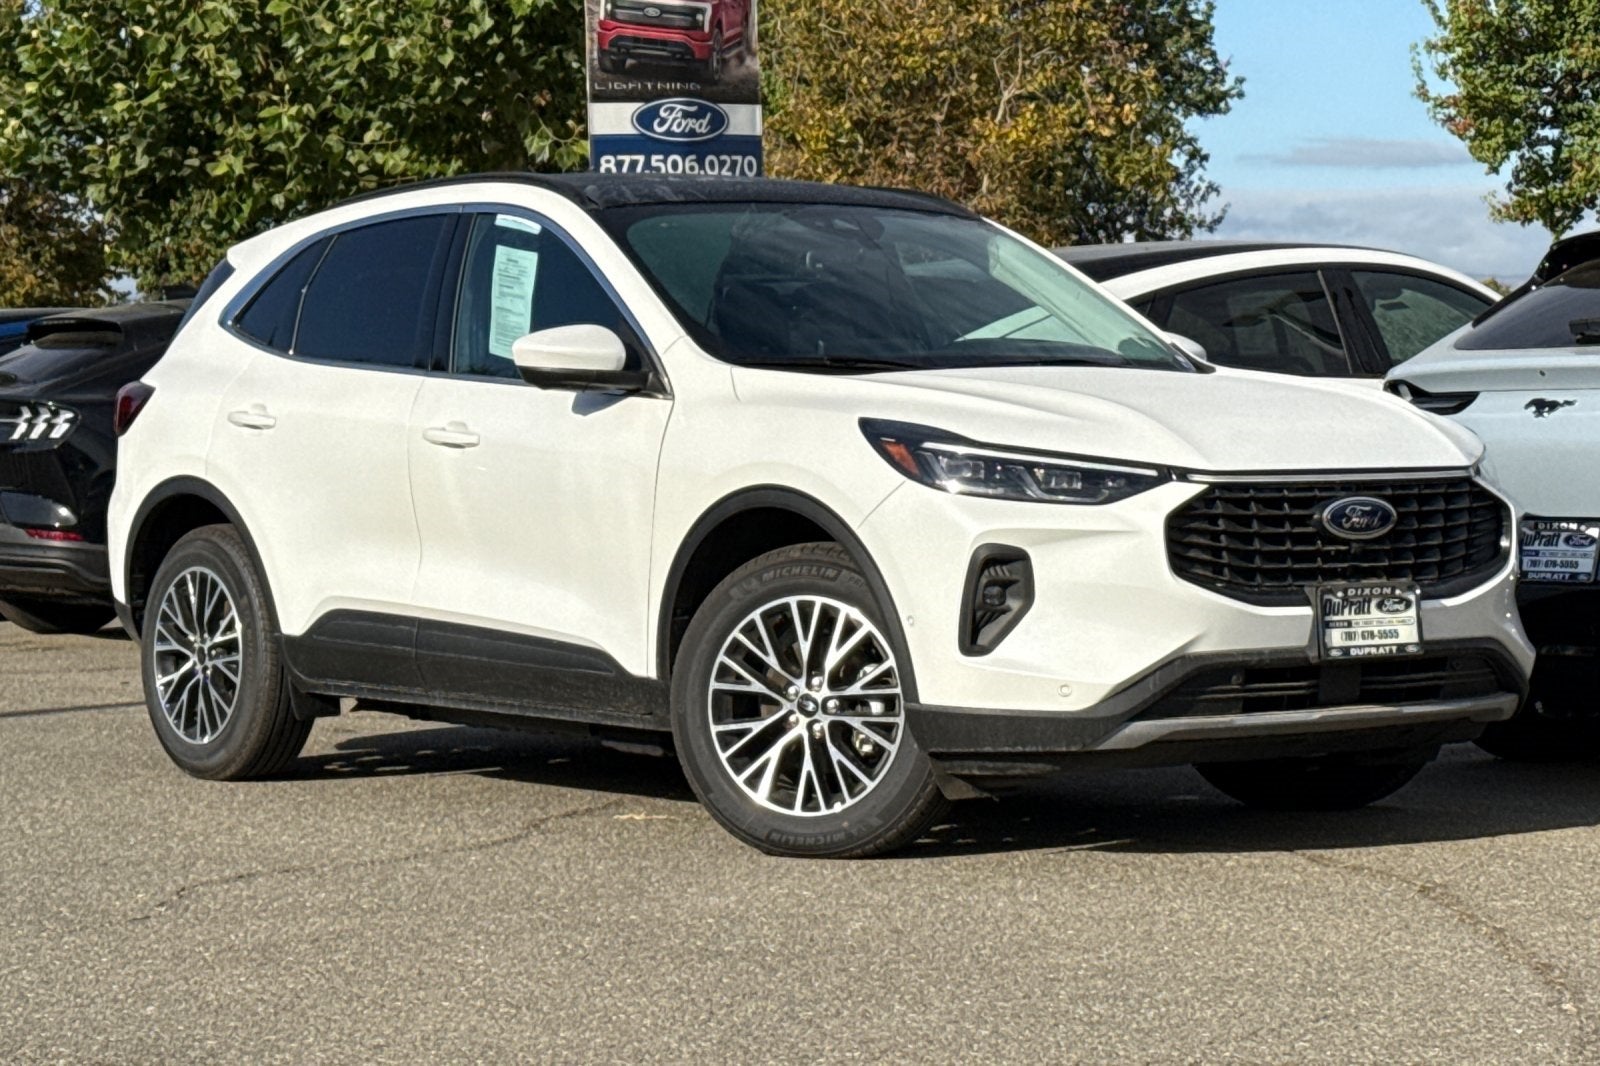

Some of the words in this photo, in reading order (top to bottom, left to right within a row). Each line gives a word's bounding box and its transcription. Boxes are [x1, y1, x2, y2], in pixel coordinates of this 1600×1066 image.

[594, 81, 701, 91] LIGHTNING
[653, 103, 711, 133] Ford
[600, 154, 757, 177] 877.506.0270
[1342, 505, 1384, 529] Ford
[1538, 522, 1578, 530] DIXON
[762, 565, 838, 582] MICHELIN
[1347, 587, 1392, 596] DIXON
[1325, 597, 1372, 617] DuPratt
[1381, 598, 1407, 611] Ford
[1350, 646, 1398, 656] DUPRATT
